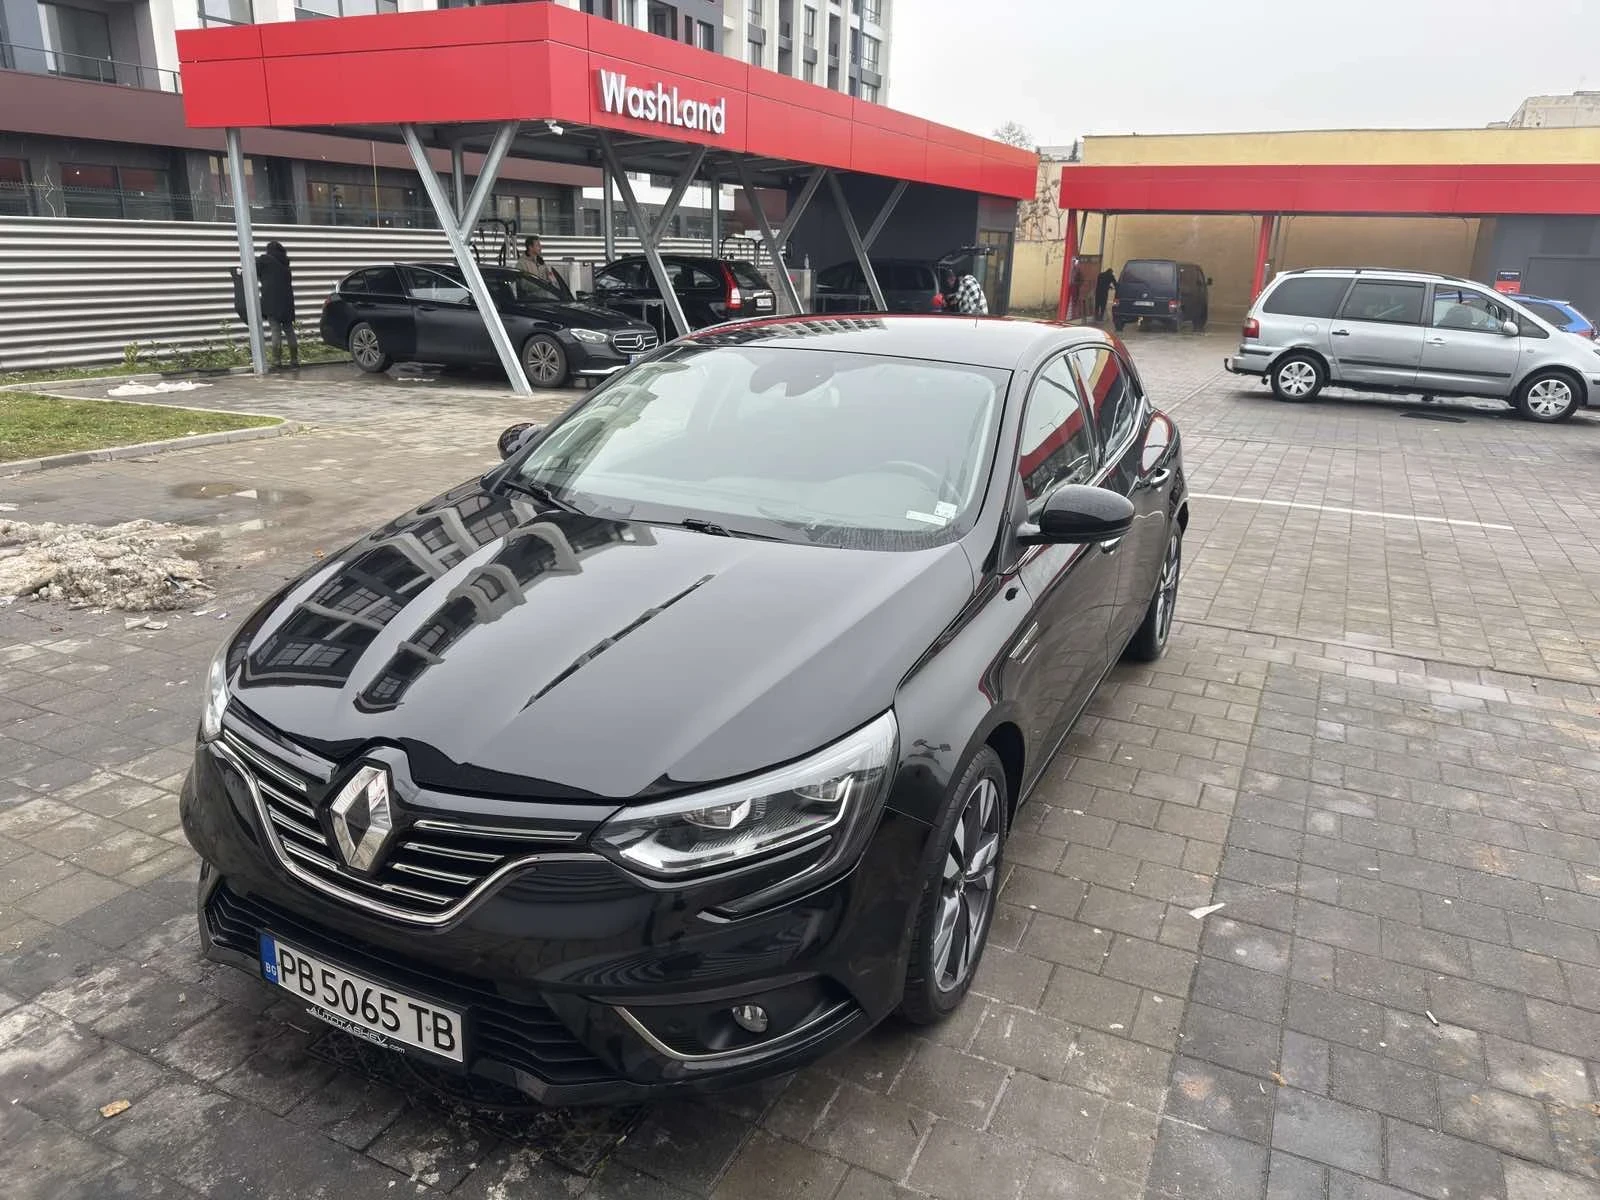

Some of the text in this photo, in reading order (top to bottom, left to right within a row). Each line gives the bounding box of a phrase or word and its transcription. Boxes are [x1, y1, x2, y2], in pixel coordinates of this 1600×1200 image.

[599, 68, 726, 134] WashLand
[264, 962, 277, 977] BG
[279, 948, 456, 1052] PB 5065 TB
